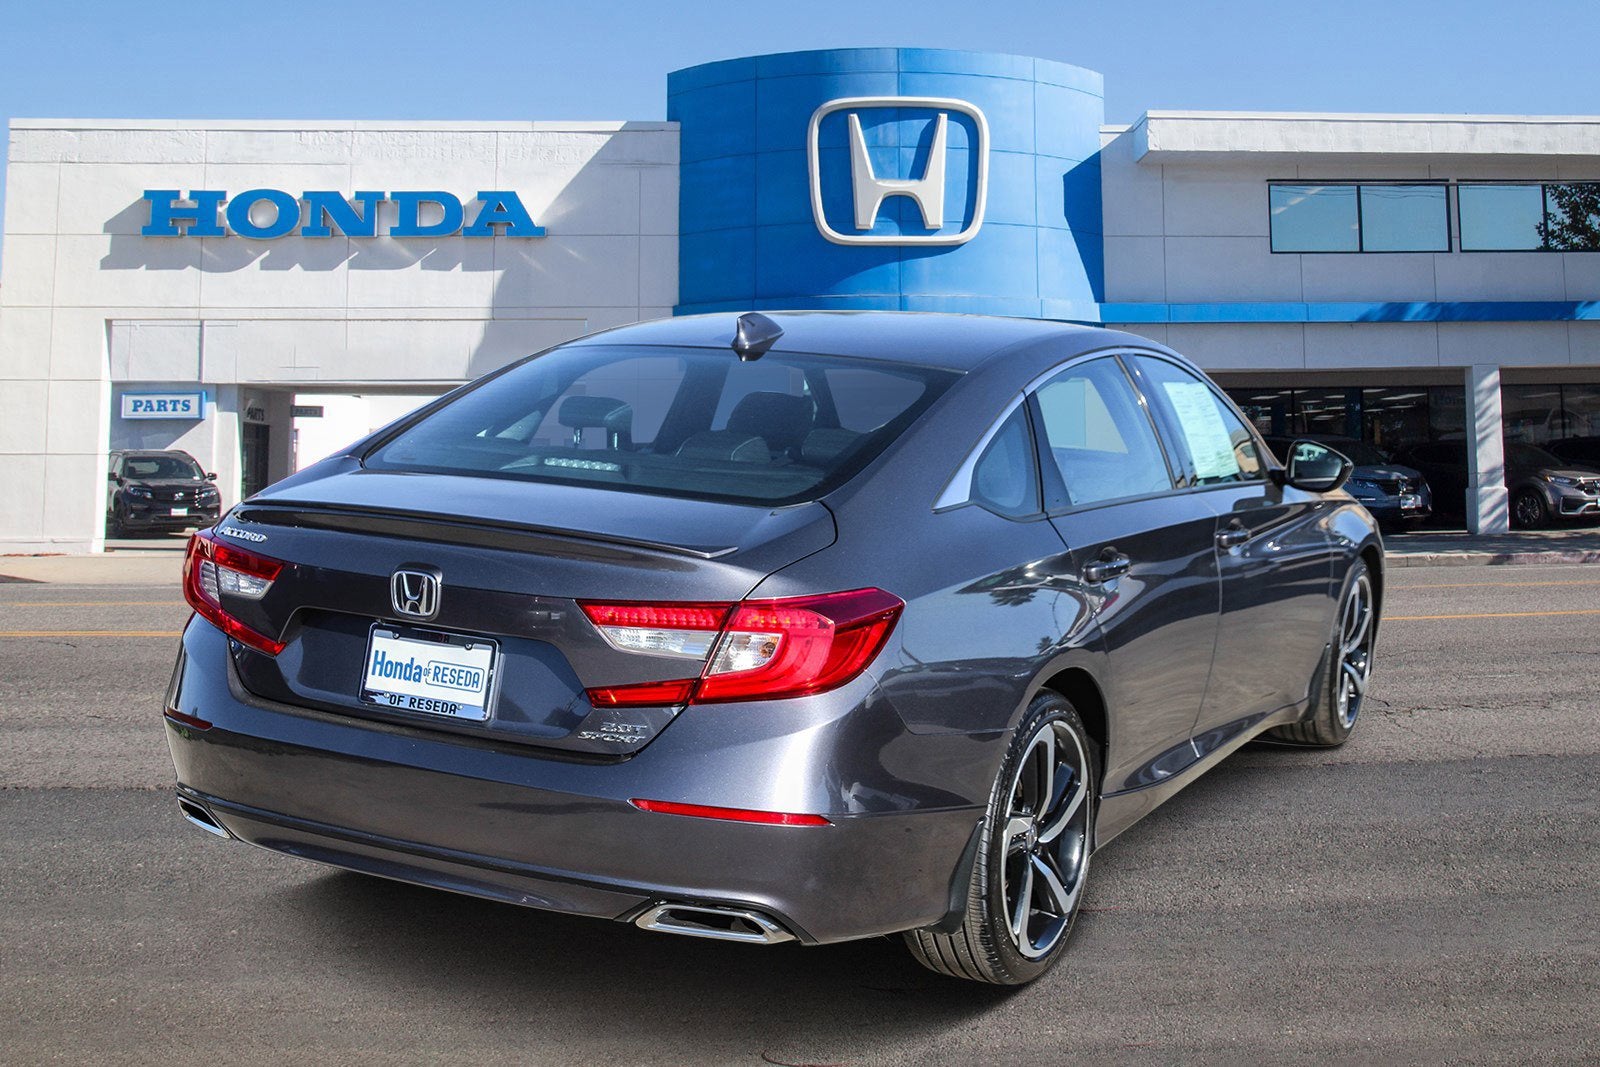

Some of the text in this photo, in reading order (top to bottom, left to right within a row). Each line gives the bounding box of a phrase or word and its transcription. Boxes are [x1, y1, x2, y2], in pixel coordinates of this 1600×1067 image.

[141, 188, 548, 239] HONDA
[131, 399, 192, 413] PARTS
[221, 526, 268, 542] ACCORD
[371, 649, 481, 689] Honda OF RESEDA
[389, 694, 458, 715] OF RESEDA
[577, 731, 647, 744] SPORT
